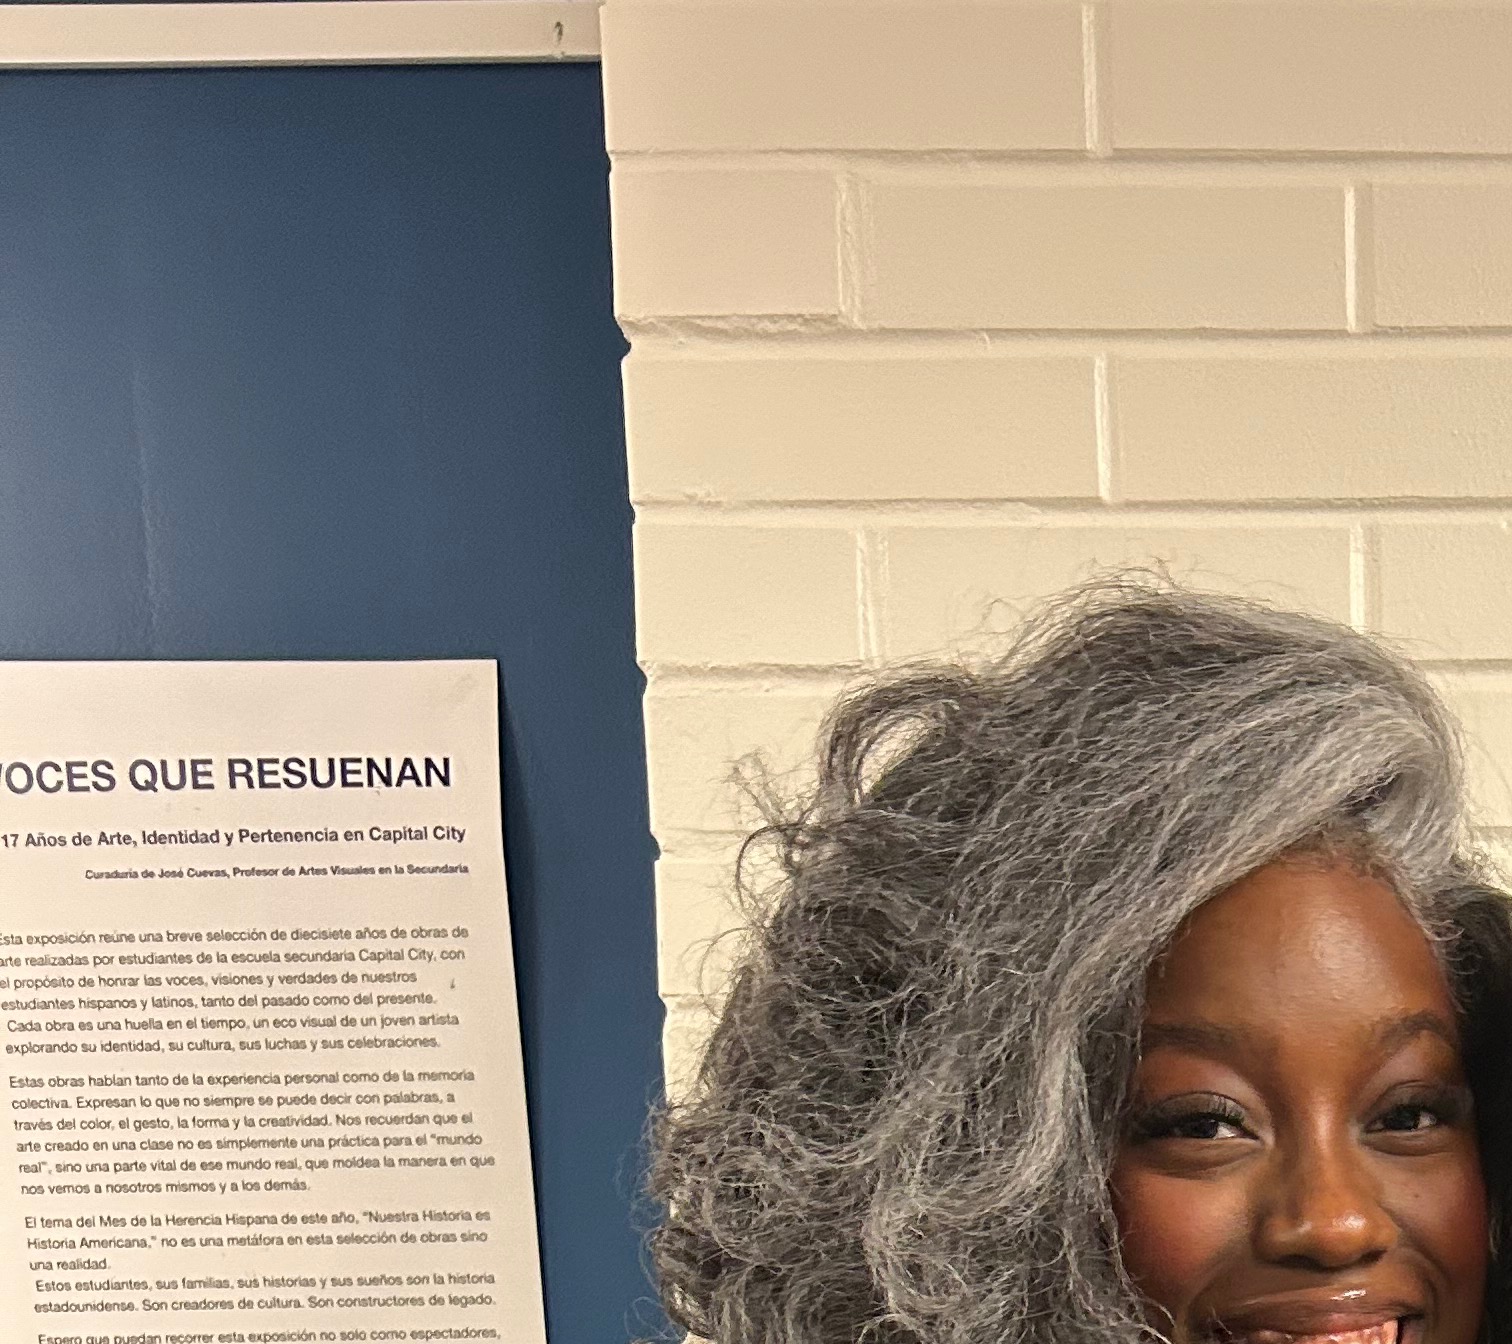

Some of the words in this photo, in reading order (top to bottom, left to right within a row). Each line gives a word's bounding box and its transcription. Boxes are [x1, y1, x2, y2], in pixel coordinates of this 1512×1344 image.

[0, 759, 116, 794] OCES
[128, 758, 214, 792] QUE
[227, 757, 450, 789] RESUENAN
[0, 833, 19, 847] 17
[24, 832, 67, 847] Años
[71, 831, 92, 846] de
[97, 831, 137, 847] Arte,
[141, 829, 220, 845] Identidad
[223, 832, 233, 846] y
[238, 827, 338, 843] Pertenencia
[343, 830, 364, 841] en
[368, 826, 428, 844] Capital
[432, 825, 466, 843] City
[26, 931, 96, 947] exposición
[98, 933, 135, 943] reúne
[138, 932, 163, 943] una
[165, 929, 202, 942] breve
[205, 927, 267, 942] selección
[270, 928, 287, 941] de
[290, 928, 351, 941] diecisiete
[355, 926, 387, 939] años
[390, 926, 407, 939] de
[410, 925, 448, 938] obras
[451, 925, 469, 938] de
[24, 953, 89, 966] realizadas
[92, 955, 114, 967] por
[118, 951, 193, 965] estudiantes
[196, 951, 212, 964] de
[216, 951, 228, 963] la
[230, 950, 281, 963] escuela
[283, 949, 356, 963] secundaria
[358, 948, 404, 963] Capital
[440, 950, 465, 960] con
[0, 997, 75, 1010] estudiantes
[78, 997, 137, 1011] hispanos
[139, 999, 147, 1011] y
[200, 995, 235, 1007] tanto
[237, 994, 258, 1007] del
[261, 994, 310, 1009] pasado
[312, 995, 350, 1006] como
[352, 992, 373, 1005] del
[5, 1041, 77, 1056] explorando
[80, 1042, 97, 1052] su
[168, 1041, 183, 1051] su
[238, 1040, 261, 1050] sus
[264, 1037, 307, 1050] luchas
[309, 1039, 317, 1052] y
[320, 1039, 344, 1049] sus
[8, 1075, 45, 1088] Estas
[47, 1075, 85, 1087] obras
[88, 1074, 132, 1087] hablan
[135, 1074, 169, 1086] tanto
[172, 1073, 189, 1086] de
[192, 1072, 204, 1085] la
[207, 1073, 281, 1087] experiencia
[283, 1071, 339, 1086] personal
[342, 1072, 379, 1083] como
[382, 1070, 399, 1082] de
[402, 1069, 414, 1081] la
[417, 1070, 474, 1081] memoria
[29, 1261, 53, 1270] una
